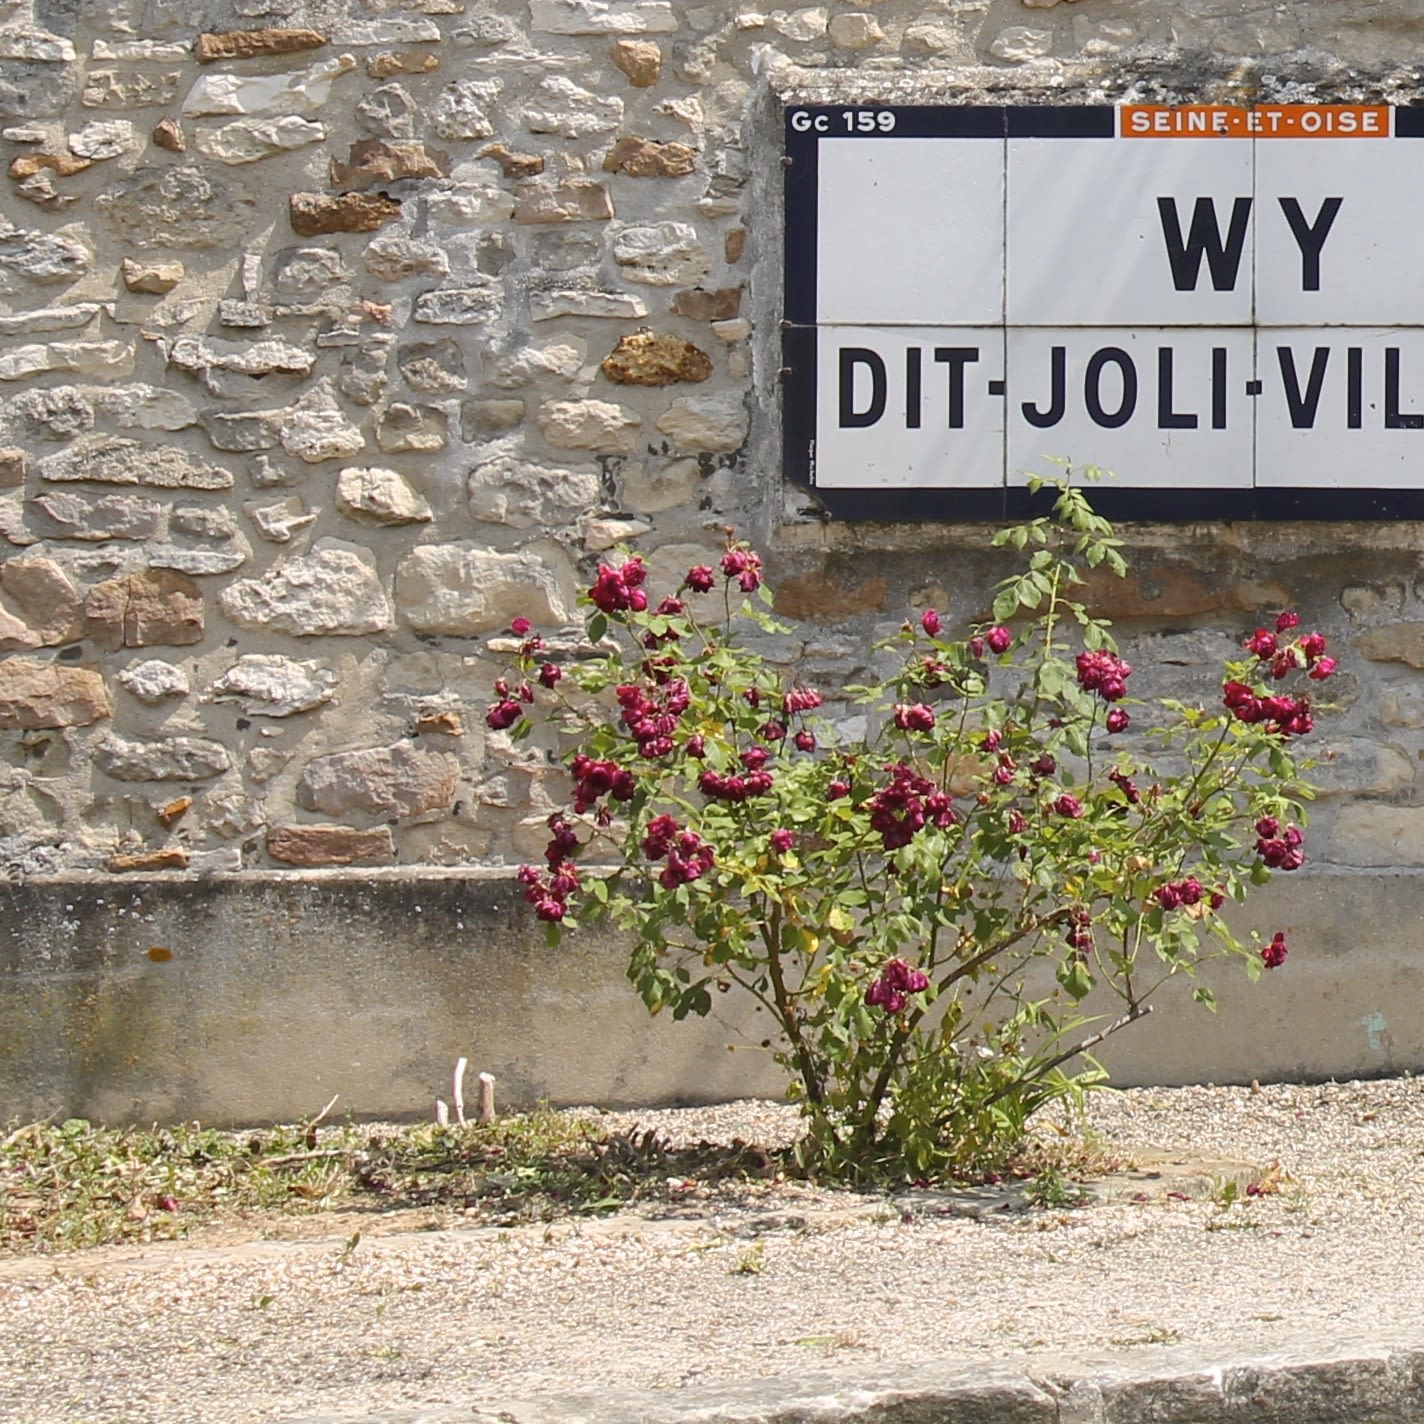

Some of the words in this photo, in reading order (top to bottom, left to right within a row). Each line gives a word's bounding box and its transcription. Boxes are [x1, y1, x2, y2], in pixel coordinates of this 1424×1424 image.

[791, 111, 829, 132] Gc
[842, 111, 896, 132] 159
[1131, 111, 1379, 132] SEINE-ET-OISE
[1156, 196, 1344, 292] WY
